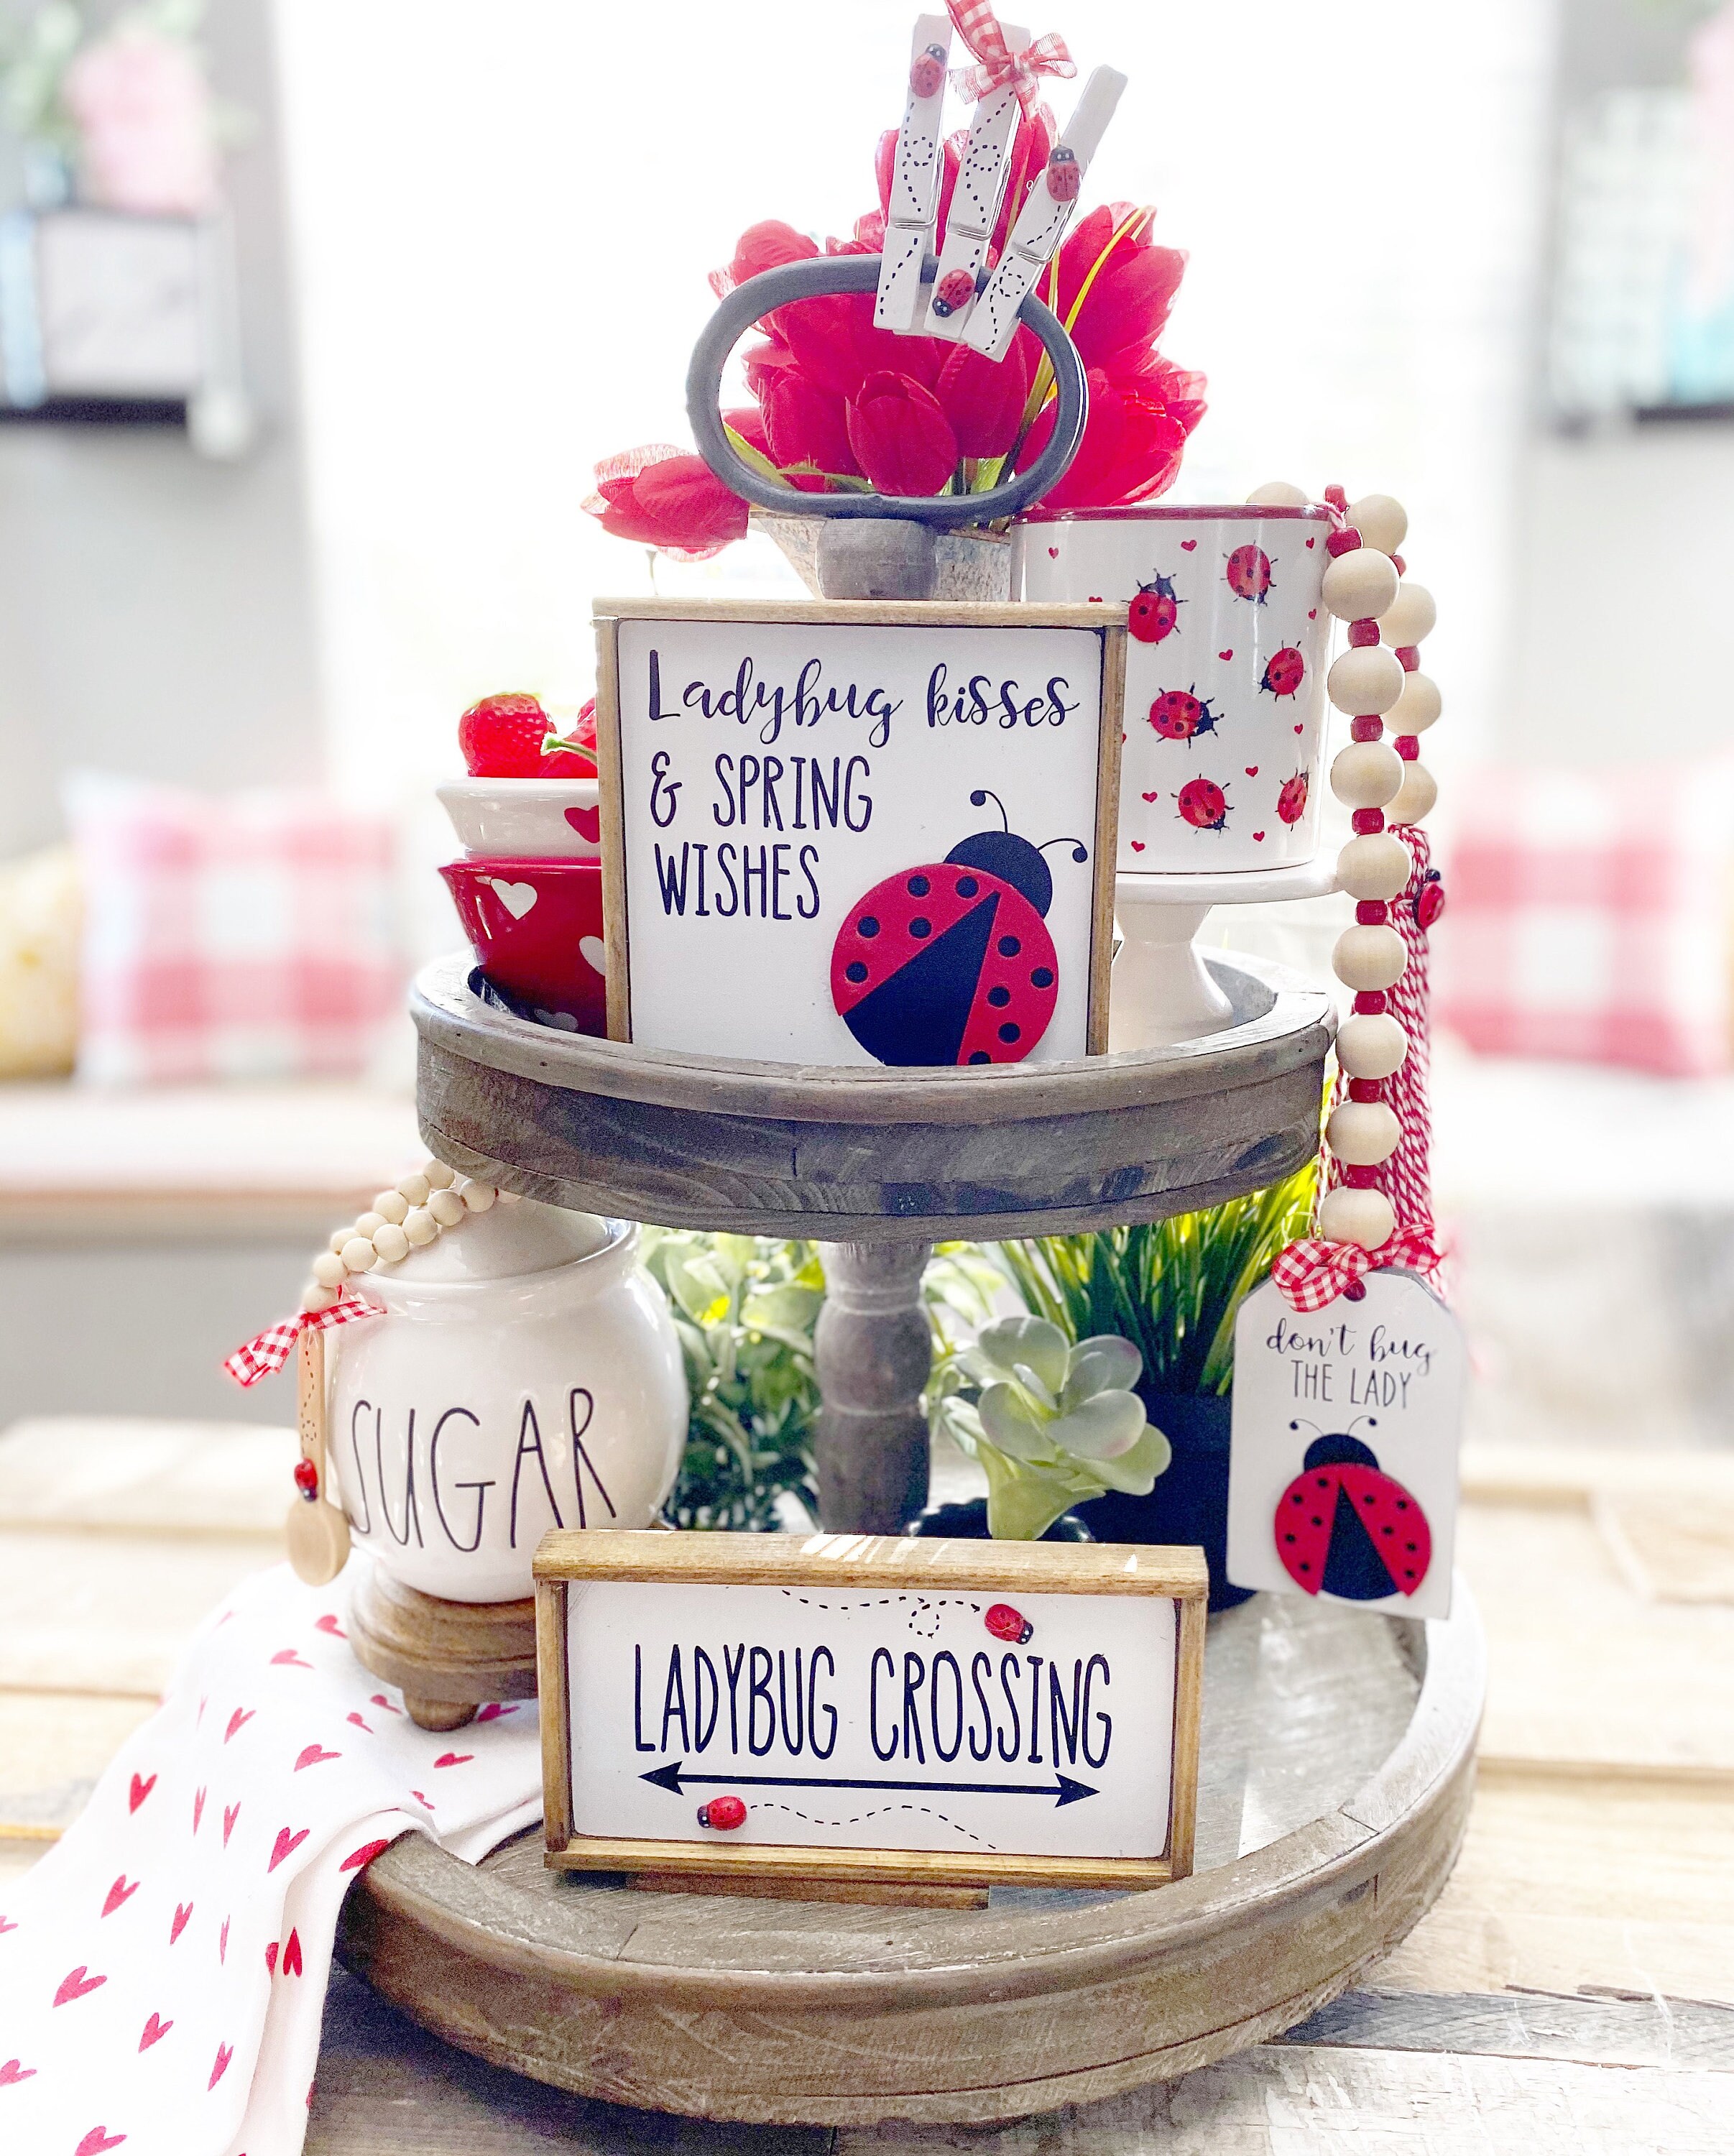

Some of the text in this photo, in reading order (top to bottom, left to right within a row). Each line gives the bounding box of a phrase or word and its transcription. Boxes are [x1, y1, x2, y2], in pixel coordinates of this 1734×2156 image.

[648, 649, 1080, 748] Ladybug kisses
[649, 750, 873, 832] & SPRING
[654, 842, 821, 921] WISHES
[1266, 1317, 1438, 1376] don't bug
[1290, 1359, 1412, 1410] THE LADY
[350, 1387, 617, 1553] SUGAR
[634, 1643, 1112, 1769] LADYBUG CROSSING
